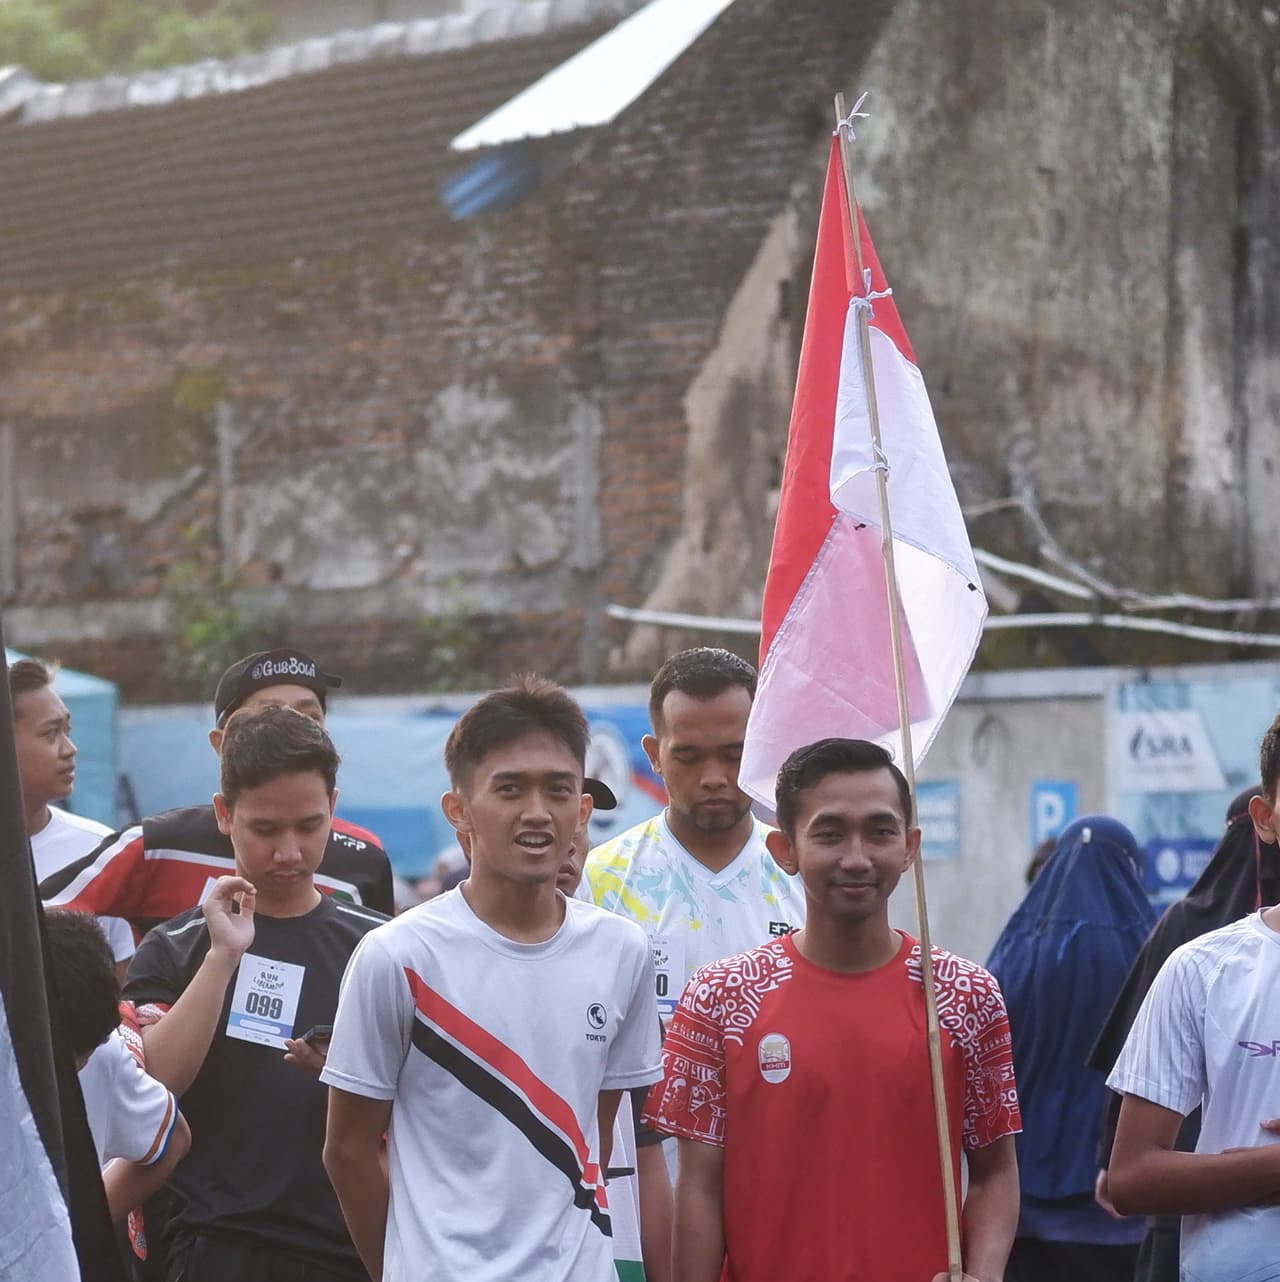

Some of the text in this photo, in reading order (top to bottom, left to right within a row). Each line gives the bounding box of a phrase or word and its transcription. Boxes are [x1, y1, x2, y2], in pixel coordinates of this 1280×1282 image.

[1036, 791, 1065, 842] P
[245, 992, 284, 1020] 099
[585, 1033, 607, 1042] TOKYO
